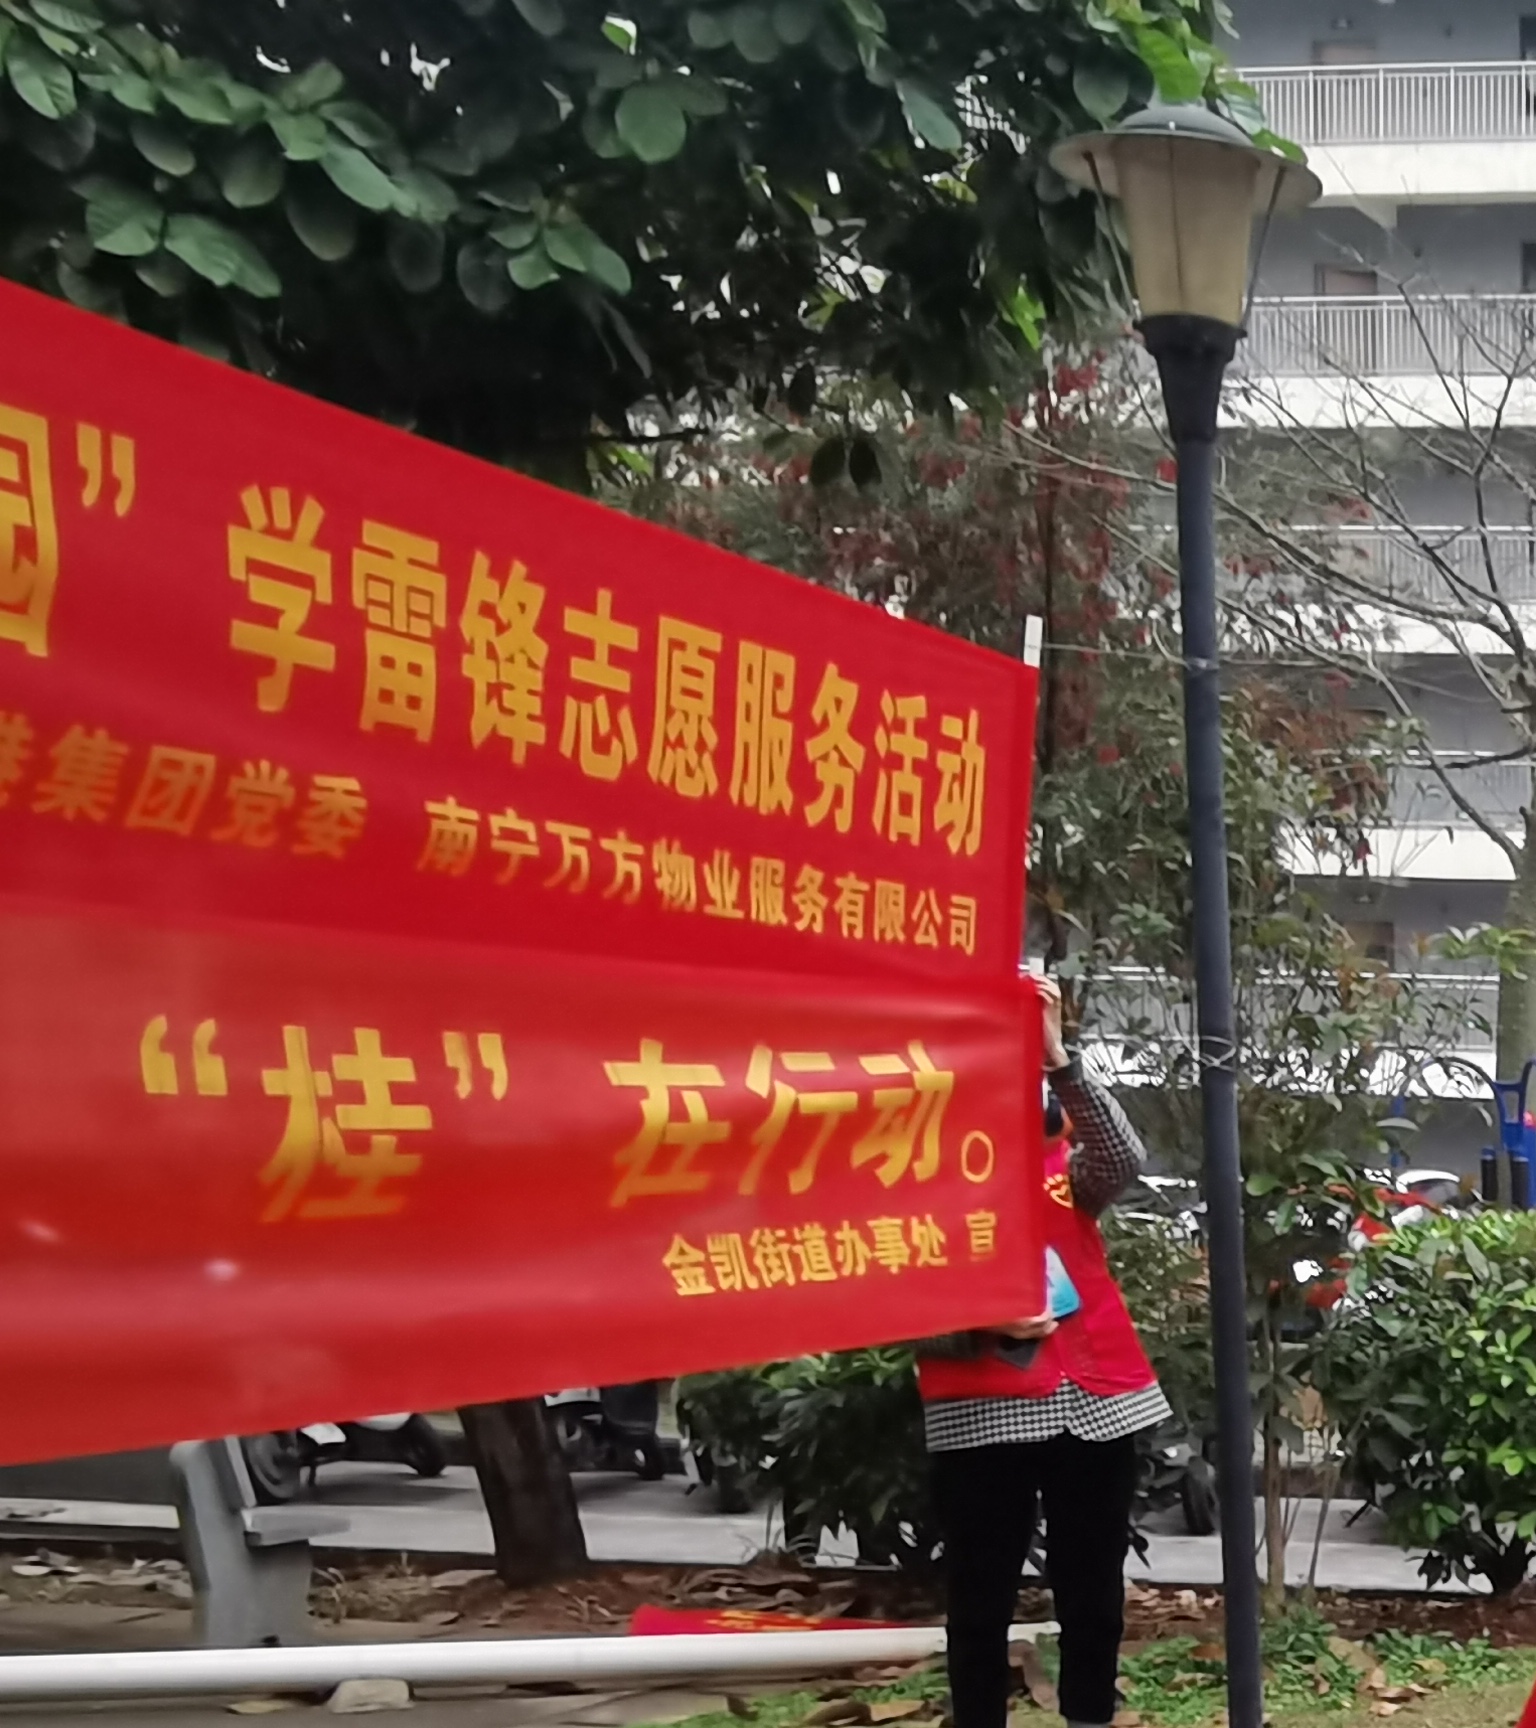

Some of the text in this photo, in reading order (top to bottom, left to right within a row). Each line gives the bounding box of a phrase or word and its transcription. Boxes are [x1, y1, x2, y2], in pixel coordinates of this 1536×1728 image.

[227, 485, 985, 856] 学雷锋志愿服务活动
[417, 796, 977, 956] 南宁万方物业服务有限公司
[602, 1038, 995, 1206] 在行动。
[661, 1208, 997, 1297] 金凯街道办事处 宣
